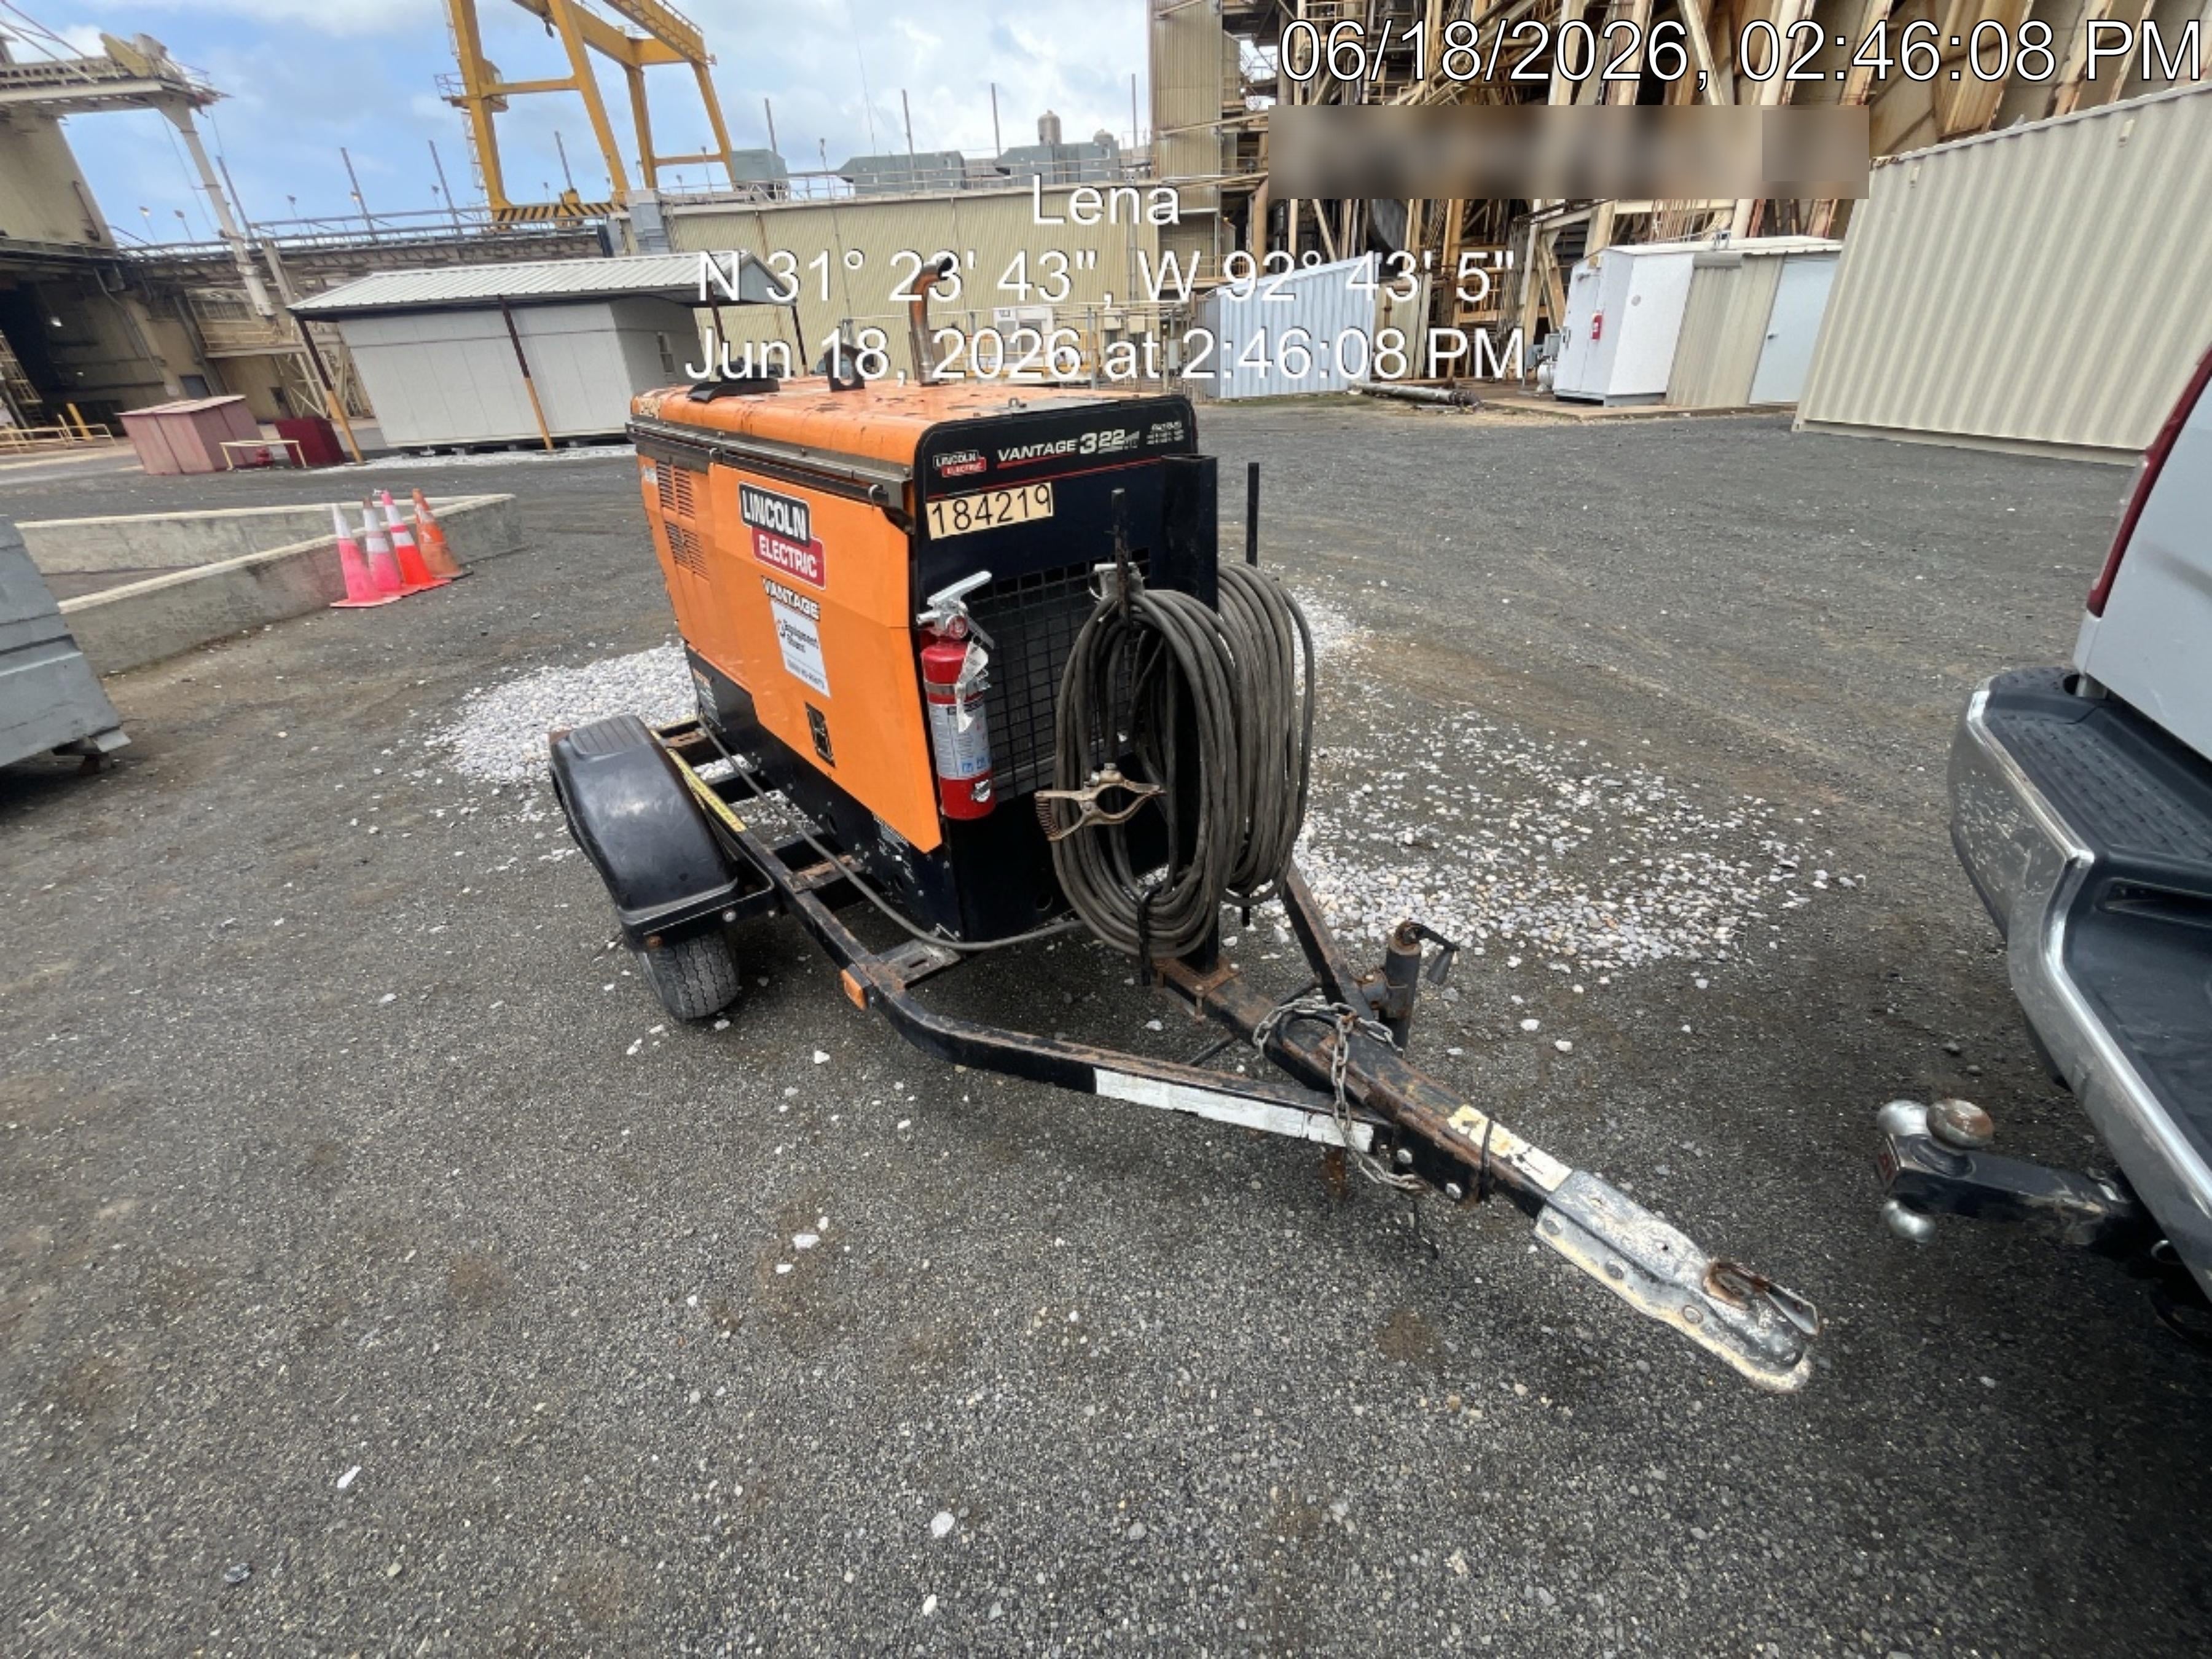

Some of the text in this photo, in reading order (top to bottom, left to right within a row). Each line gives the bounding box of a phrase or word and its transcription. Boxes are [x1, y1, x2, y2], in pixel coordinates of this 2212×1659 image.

[935, 452, 976, 468] LINCOLN
[997, 439, 1078, 461] VANTAGE
[1080, 429, 1126, 454] 322
[742, 490, 807, 541] LINCOLN
[931, 484, 1051, 535] 184219
[758, 533, 818, 578] ELECTRIC
[763, 578, 820, 621] VANTAGE
